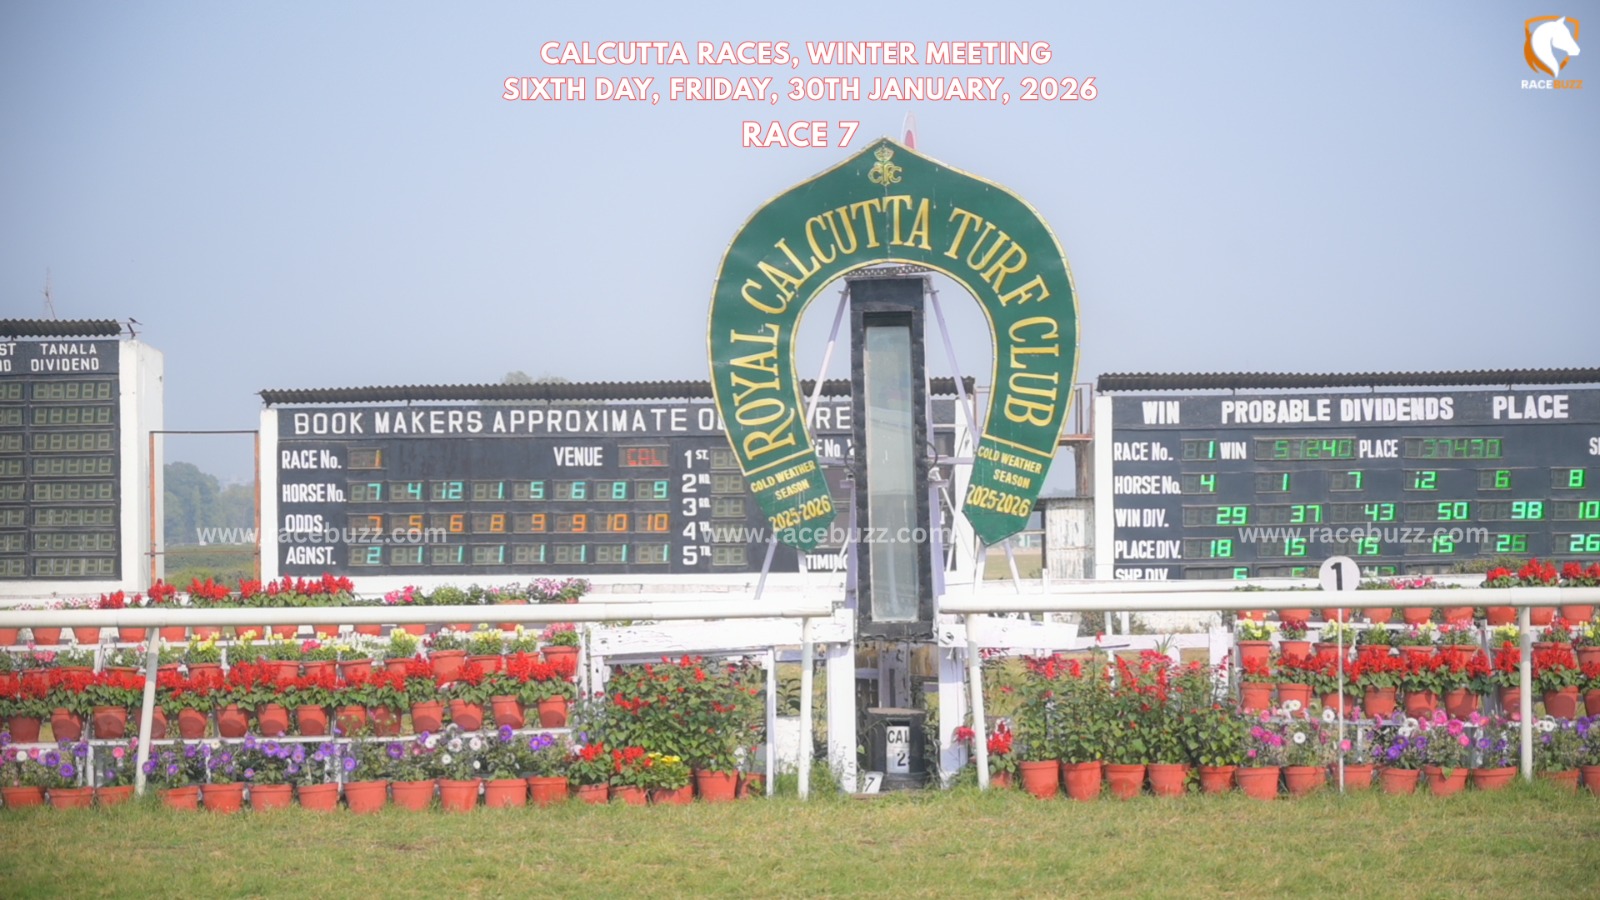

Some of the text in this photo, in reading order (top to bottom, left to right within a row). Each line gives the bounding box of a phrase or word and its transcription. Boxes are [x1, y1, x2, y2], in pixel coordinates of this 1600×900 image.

[730, 195, 1059, 461] ROYAL CALCUTTA TURF CLUB
[41, 343, 97, 356] TANALA
[31, 358, 99, 372] DIVIDEND
[1142, 401, 1179, 424] WIN
[1221, 397, 1453, 424] PROBABLE DIVIDENDS
[1493, 395, 1569, 419] PLACE
[294, 412, 363, 434] BOOK
[375, 410, 483, 433] MAKERS
[492, 409, 687, 433] APPROXIMATE
[553, 447, 603, 466] VENUE
[1114, 442, 1173, 461] RACE No.
[1208, 440, 1214, 458] 1
[1220, 442, 1247, 459] WIN
[1359, 439, 1398, 458] PLACE
[1424, 438, 1500, 458] 37430
[282, 450, 342, 469] RACE No.
[374, 449, 382, 468] 1
[978, 446, 1042, 474] COLD WEATHER
[750, 460, 816, 493] COLD WEATHER
[993, 469, 1030, 489] SEASON
[1115, 476, 1182, 494] HORSE No.
[1200, 474, 1214, 492] 4
[1282, 473, 1289, 491] 1
[1348, 471, 1362, 489] 7
[1495, 470, 1510, 488] 6
[1569, 469, 1583, 487] 8
[282, 484, 347, 502] HORSE No.
[368, 483, 382, 500] 7
[408, 483, 422, 500] 4
[530, 481, 544, 498] 5
[571, 481, 586, 499] 6
[612, 481, 626, 499] 8
[654, 481, 667, 498] 9
[775, 479, 810, 500] SEASON
[966, 484, 1031, 517] 2025-2026
[768, 495, 831, 532] 2025-2026
[1115, 508, 1169, 527] WIN DIV.
[1216, 507, 1247, 524] 29
[1290, 505, 1322, 522] 37
[1365, 503, 1394, 521] 43
[1438, 502, 1468, 520] 50
[1511, 501, 1543, 519] 98
[285, 514, 327, 532] ODDS.
[368, 513, 668, 533] 7 5 6 8 9 9 10 10
[366, 544, 668, 564] 2 1 1 1 1 1 1 1
[1115, 540, 1181, 559] PLACE DIV.
[1210, 534, 1600, 557] 18 15 15 15 26 26
[286, 547, 336, 565] AGNST.
[1330, 562, 1343, 590] 1
[865, 777, 875, 792] 7
